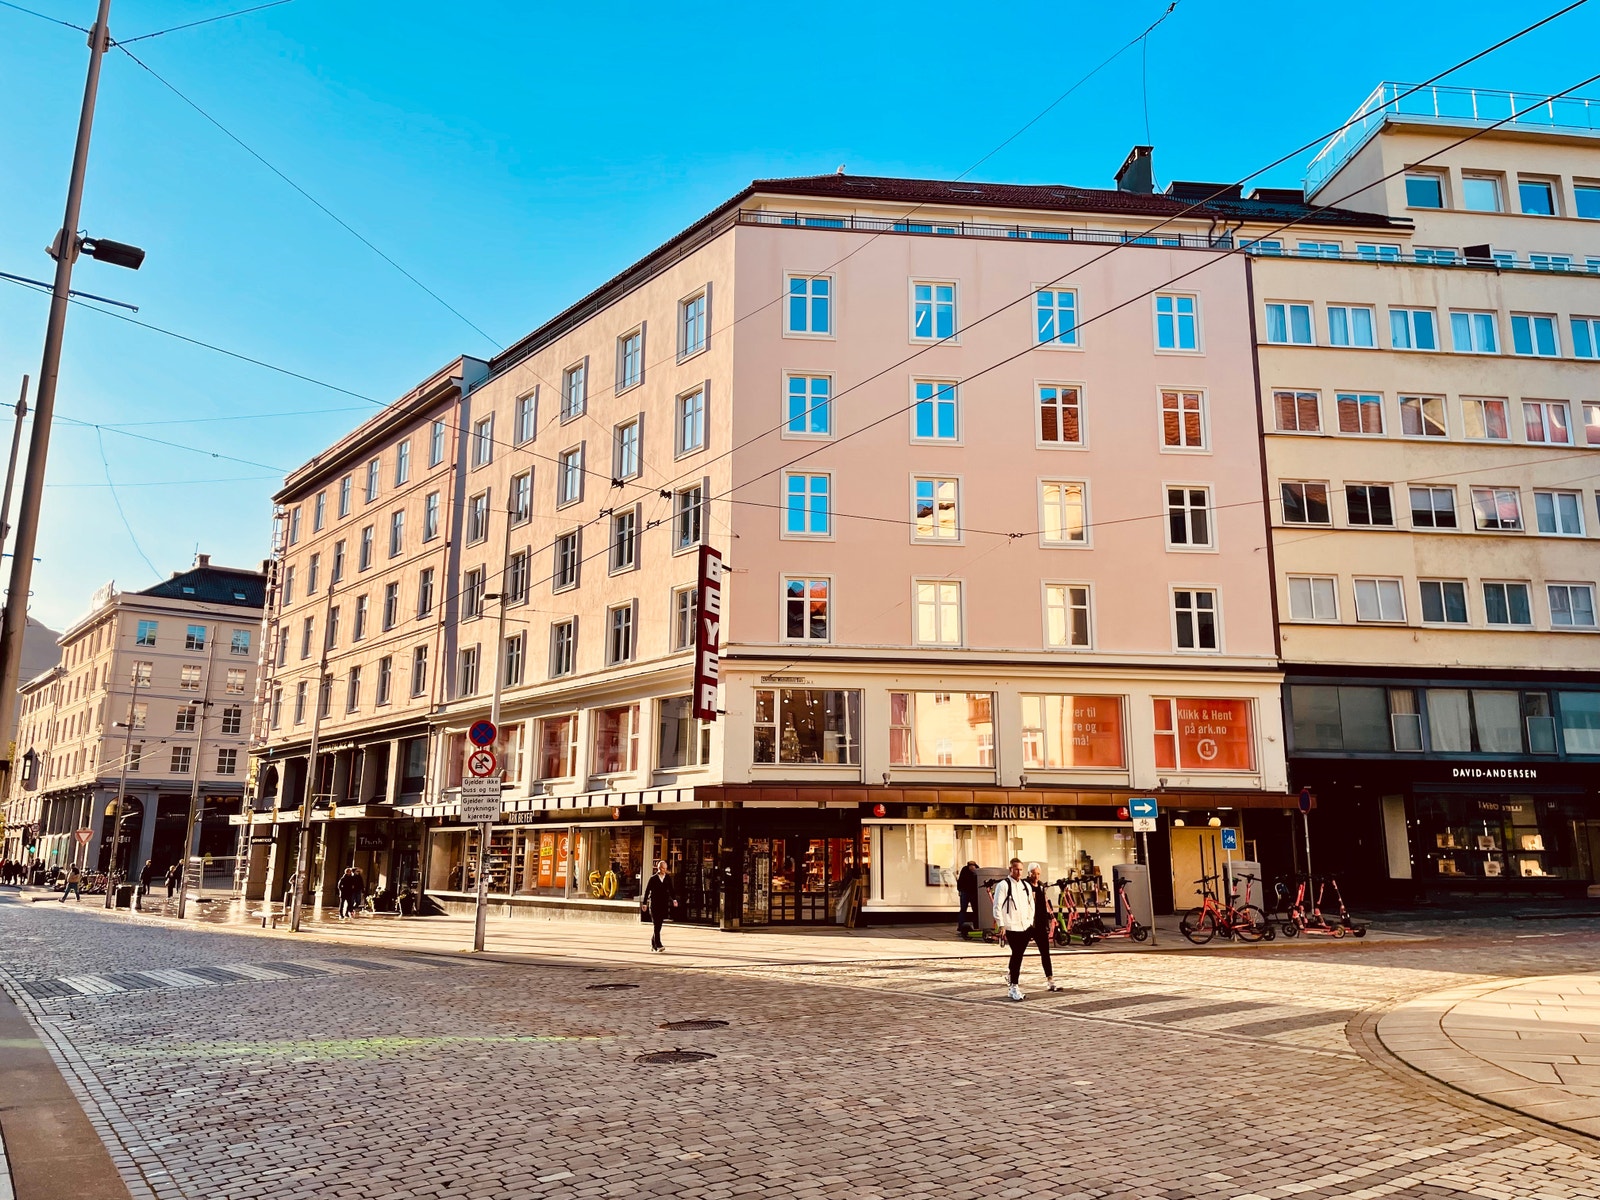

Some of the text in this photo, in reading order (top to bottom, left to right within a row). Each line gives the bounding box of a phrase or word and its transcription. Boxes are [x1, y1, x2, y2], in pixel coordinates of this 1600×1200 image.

[701, 554, 722, 710] BEYER
[1087, 706, 1096, 717] til
[1177, 709, 1232, 720] Klikk & Hent
[1085, 723, 1096, 734] og
[1184, 722, 1227, 735] på ark.no
[1452, 768, 1537, 778] DAVID-ANDERSEN
[508, 812, 533, 823] ARK BEYER
[993, 805, 1016, 819] ARK
[589, 869, 617, 899] 50
